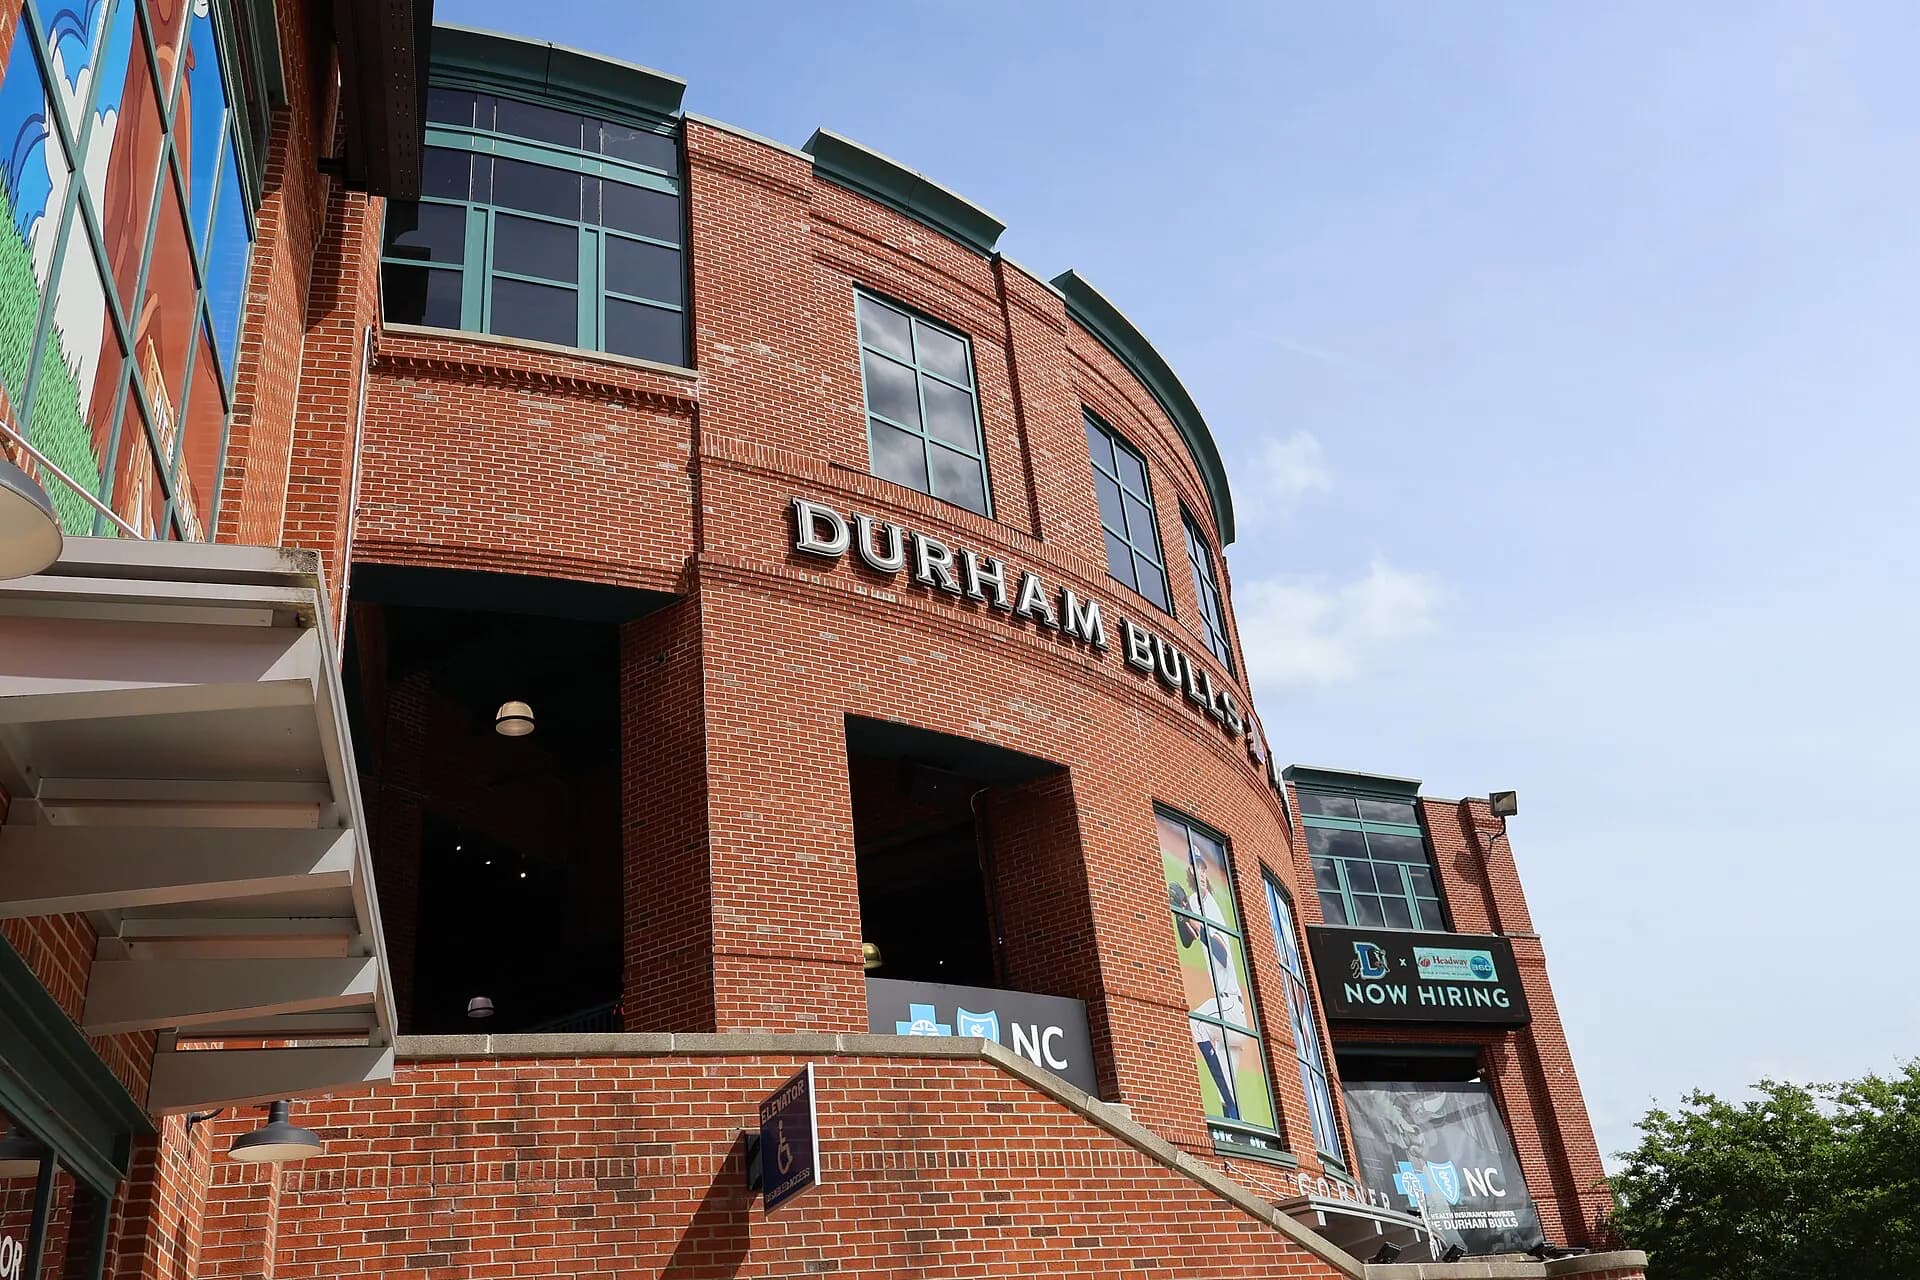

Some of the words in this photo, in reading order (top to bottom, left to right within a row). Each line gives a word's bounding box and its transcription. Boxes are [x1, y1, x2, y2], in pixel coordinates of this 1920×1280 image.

[793, 497, 1109, 651] DURHAM
[1119, 617, 1243, 737] BULLS
[1432, 955, 1468, 966] Headway
[1344, 982, 1407, 1005] NOW
[1417, 985, 1510, 1008] HIRING
[1011, 1022, 1068, 1070] NC
[761, 1080, 804, 1124] ELEVATOR
[789, 1167, 811, 1187] ACCESS
[1462, 1167, 1506, 1197] NC
[1430, 1212, 1454, 1220] HEALTH
[1454, 1210, 1487, 1219] INSURANCE
[1487, 1210, 1516, 1218] PROVIDER
[1444, 1218, 1488, 1230] DURHAM
[1488, 1217, 1519, 1228] BULLS
[0, 1235, 23, 1280] OR
